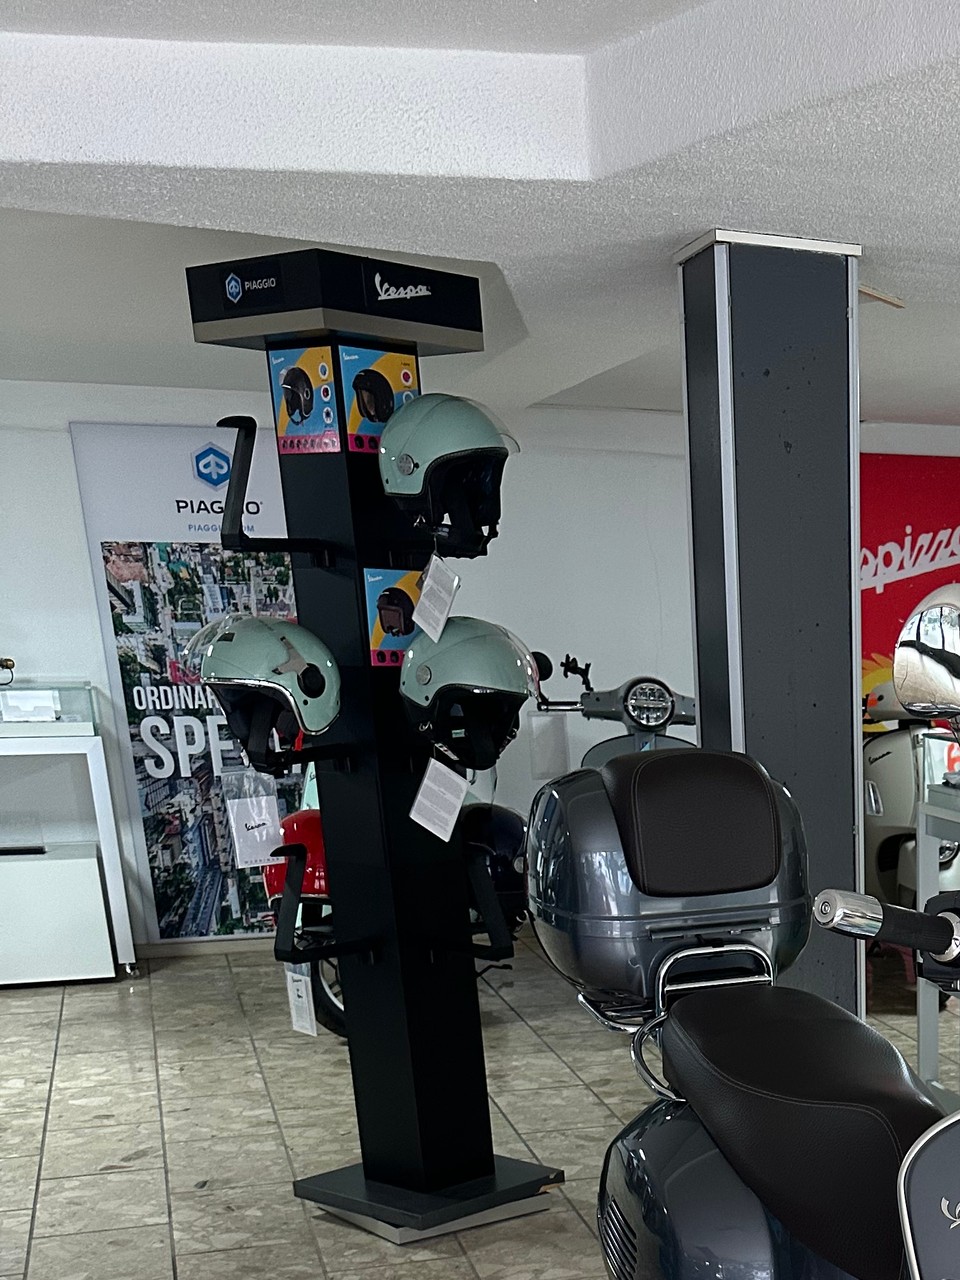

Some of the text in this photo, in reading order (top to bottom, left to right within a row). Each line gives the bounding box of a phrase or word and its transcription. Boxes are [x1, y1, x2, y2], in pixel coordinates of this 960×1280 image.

[244, 278, 276, 290] PIAGGIO
[374, 272, 431, 300] Vespa
[175, 499, 261, 515] PIAGO
[132, 685, 220, 711] ORDINAR
